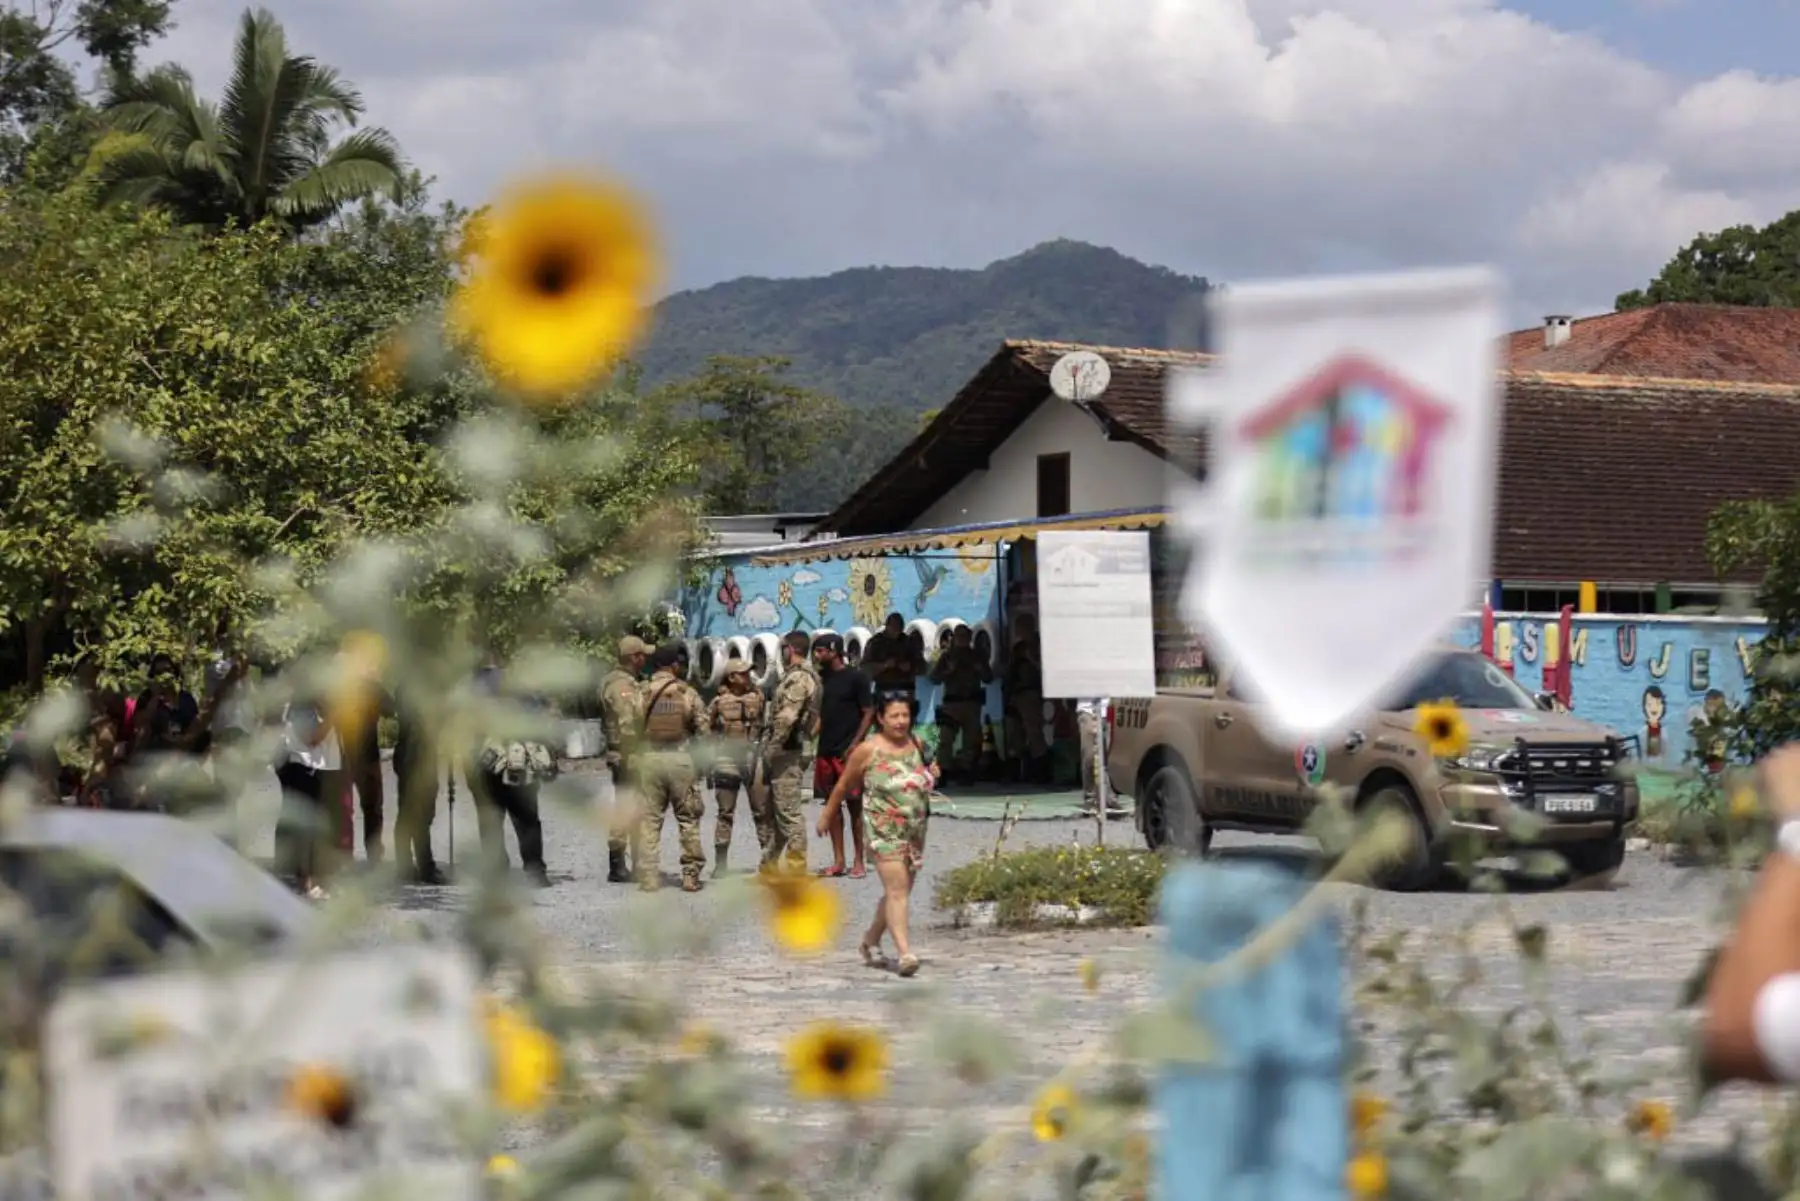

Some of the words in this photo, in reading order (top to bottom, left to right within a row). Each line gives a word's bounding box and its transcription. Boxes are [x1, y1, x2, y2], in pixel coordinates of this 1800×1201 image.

[1616, 624, 1637, 666] U
[1649, 641, 1673, 678] J
[1690, 649, 1710, 691] E
